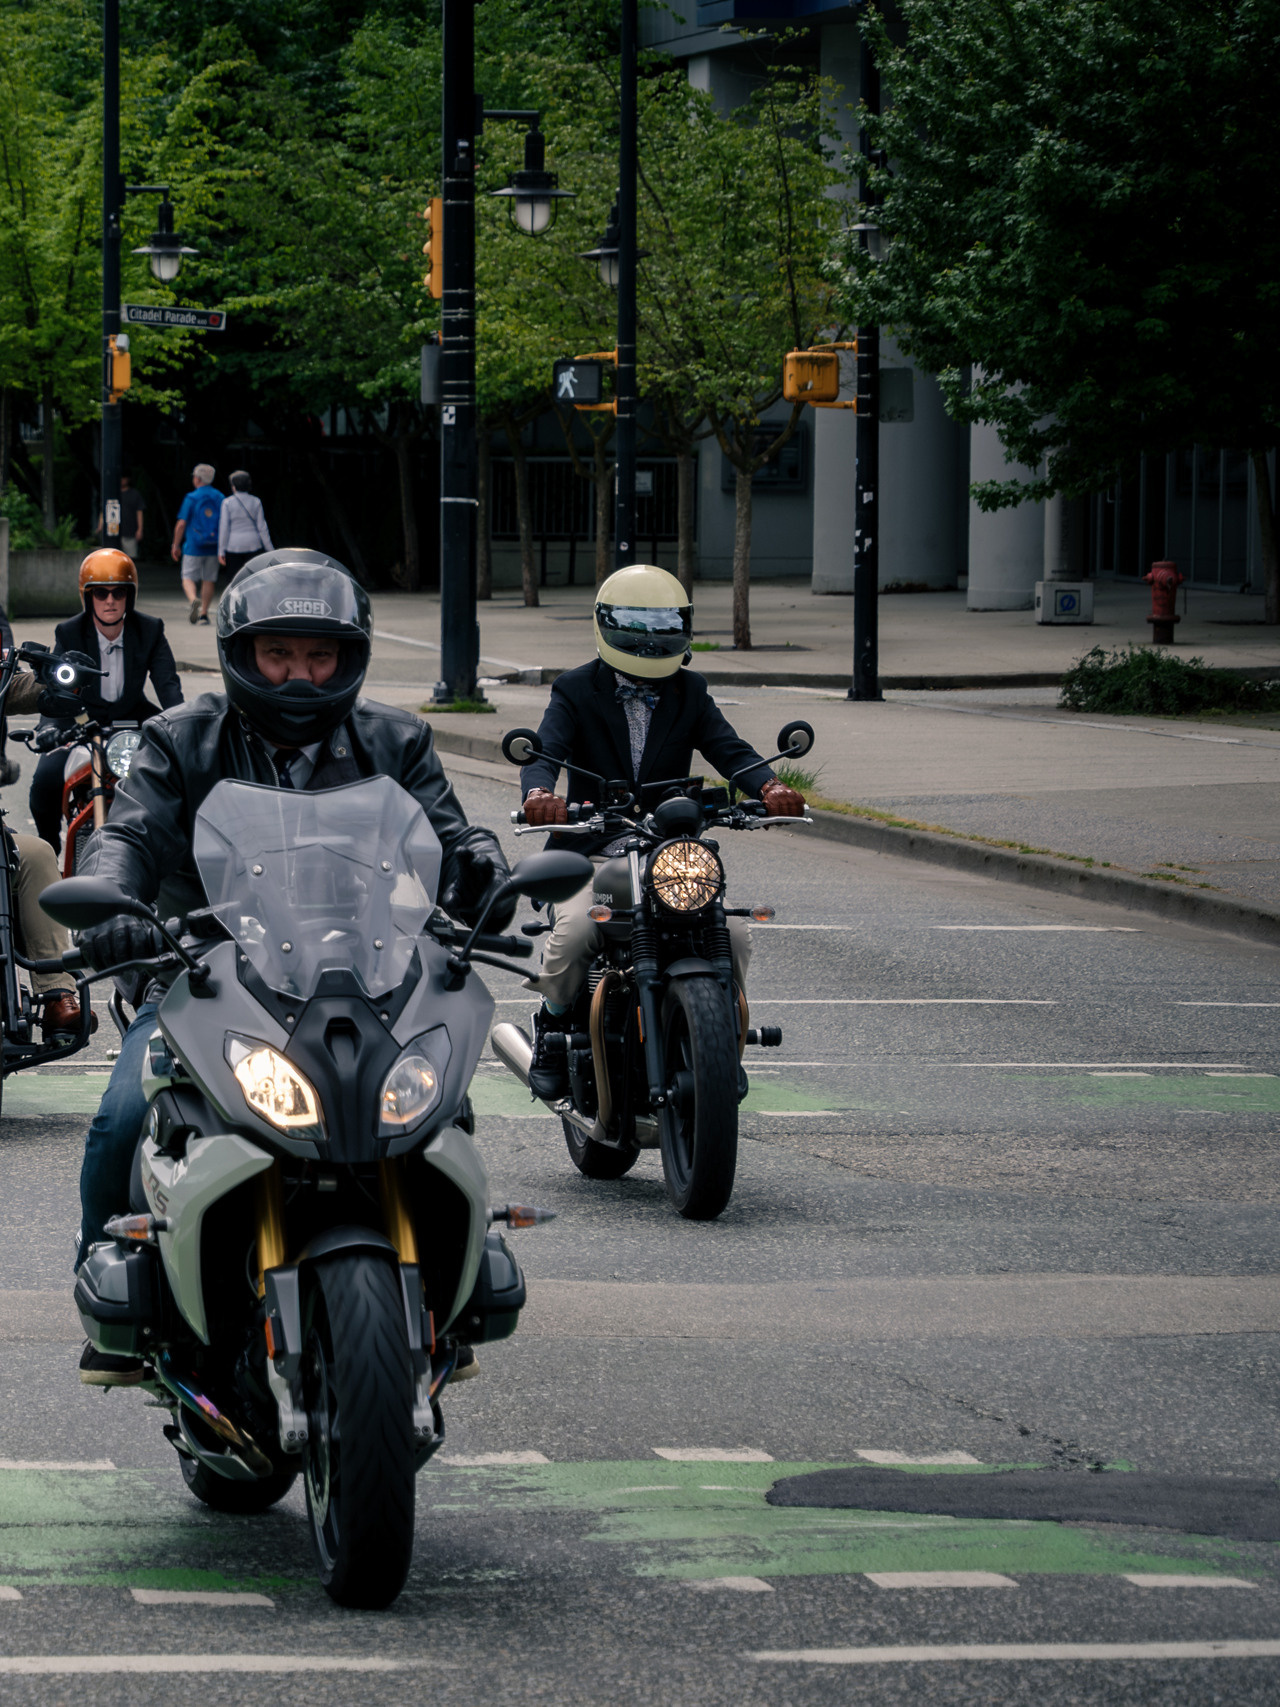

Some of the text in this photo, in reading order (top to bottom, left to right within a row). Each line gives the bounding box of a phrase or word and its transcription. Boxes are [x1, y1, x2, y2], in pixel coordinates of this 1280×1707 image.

[129, 308, 162, 321] Citadel
[164, 311, 197, 324] Parade
[284, 600, 325, 615] SHOEI
